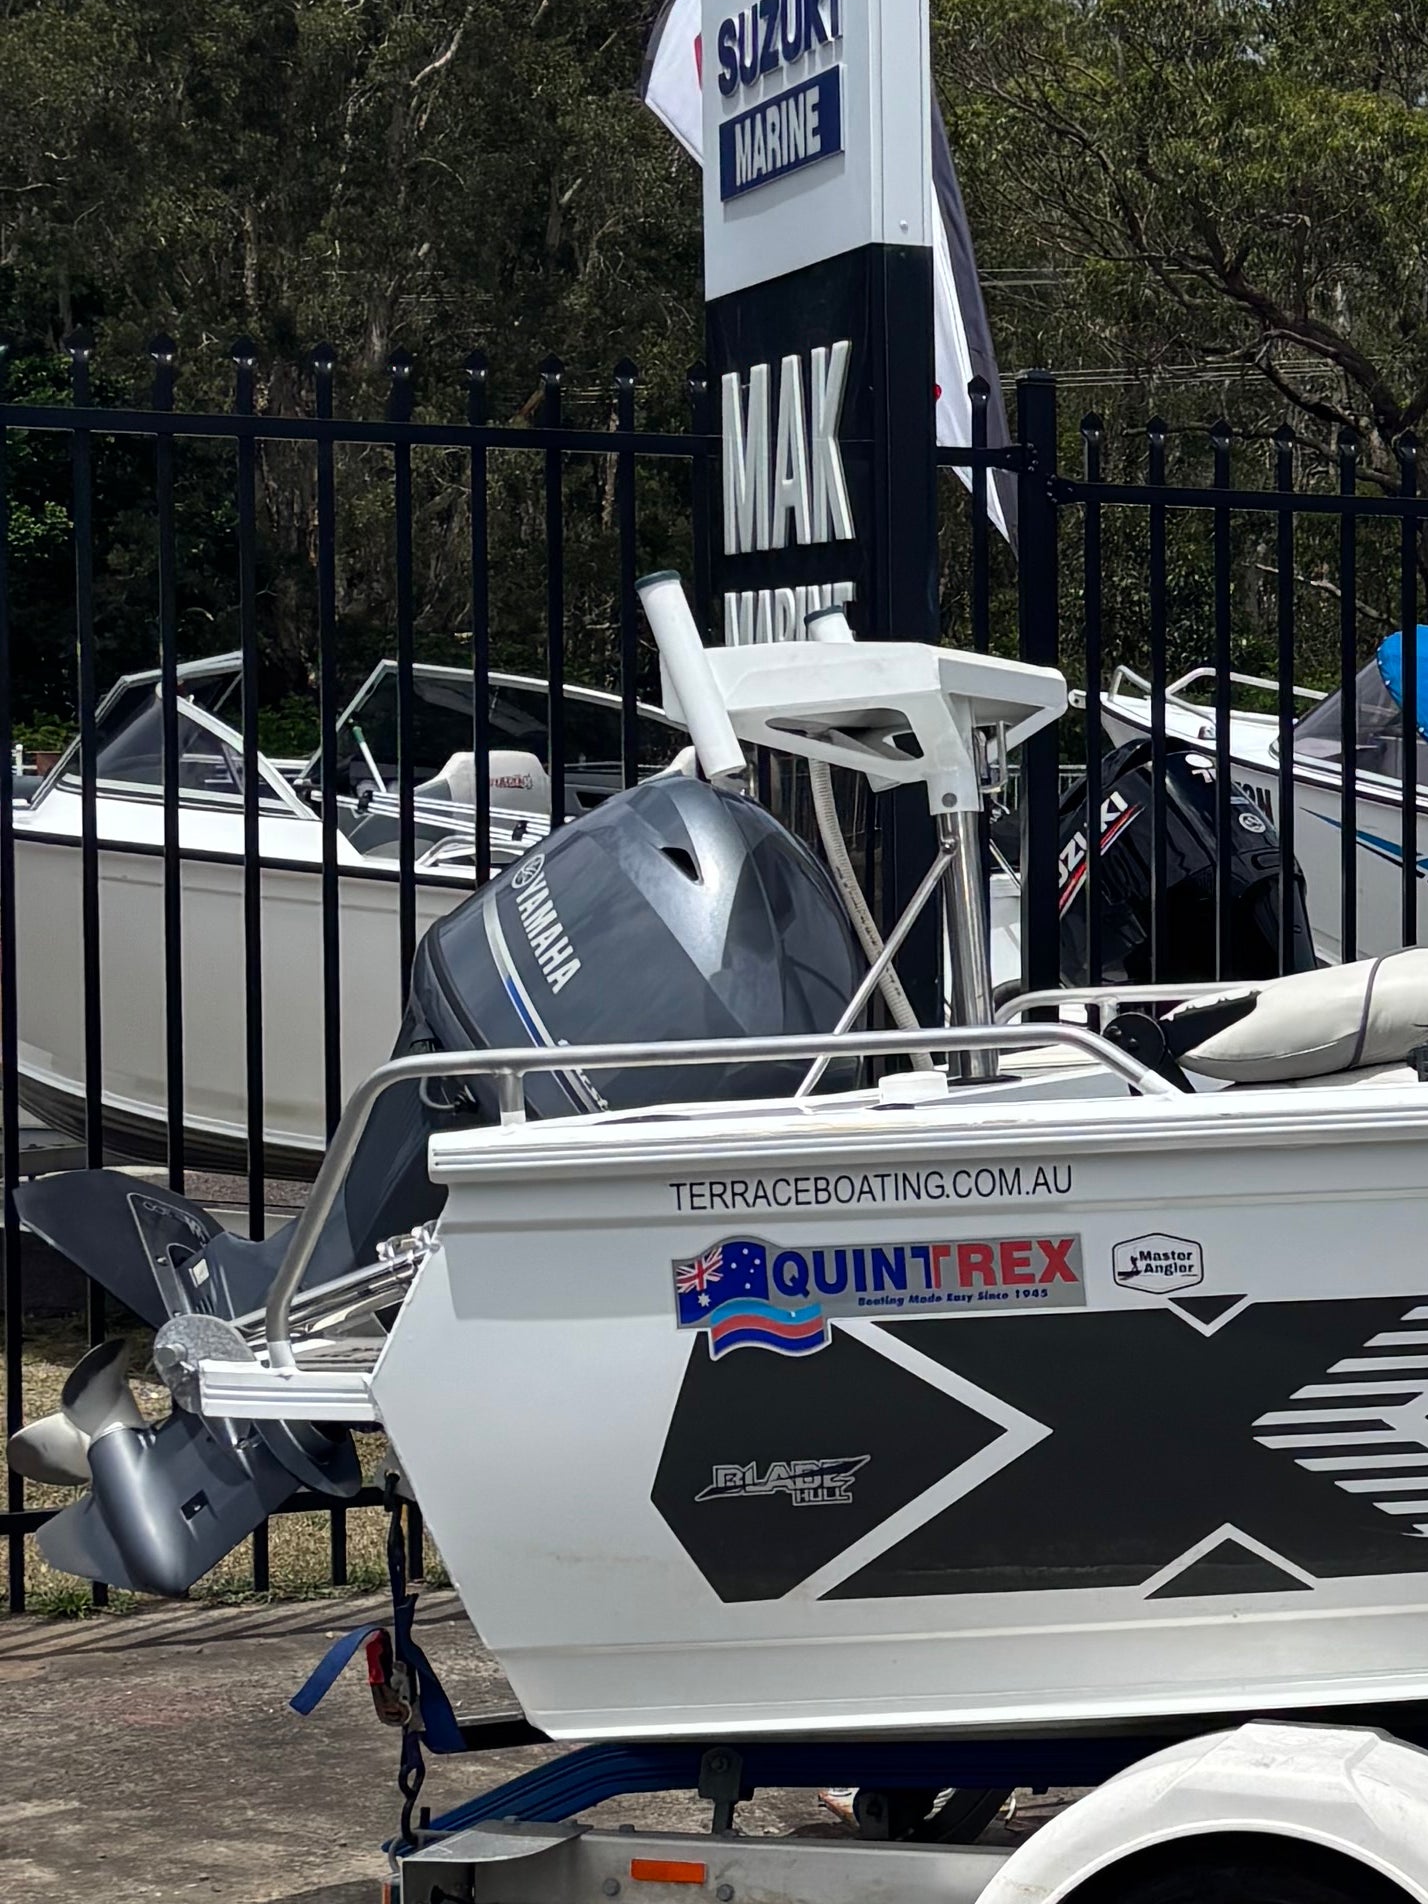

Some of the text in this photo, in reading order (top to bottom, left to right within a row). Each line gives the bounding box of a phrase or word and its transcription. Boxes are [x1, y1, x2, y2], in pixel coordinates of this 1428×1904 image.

[734, 85, 821, 187] MARINE
[721, 340, 856, 556] MAK
[516, 870, 582, 995] YAMAHA
[670, 1164, 1073, 1211] TERRACEBOATING.COM.AU
[772, 1238, 1081, 1299] QUINTREX
[1138, 1250, 1193, 1262] Master
[1143, 1262, 1195, 1276] Angler
[858, 1288, 1049, 1308] Boating Made Easy Since 1945
[695, 1455, 871, 1501] BLADE
[793, 1488, 852, 1506] HULL
